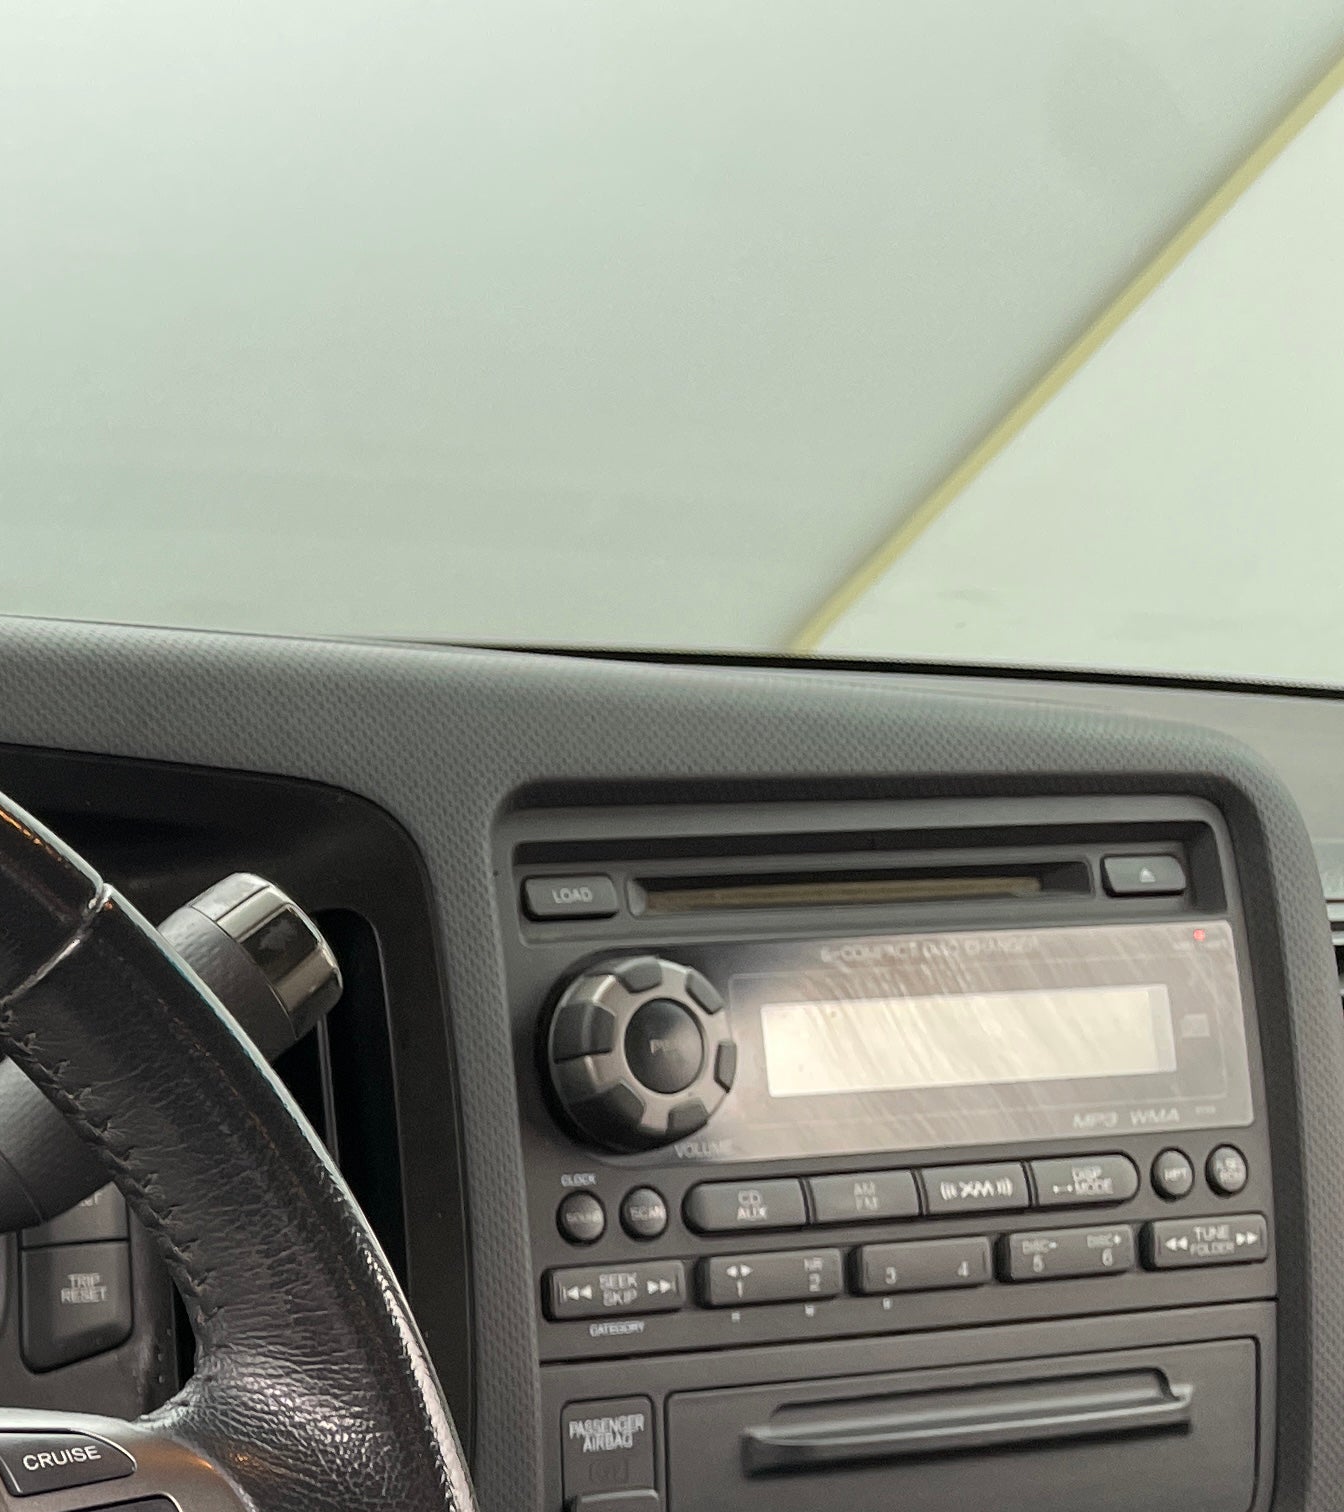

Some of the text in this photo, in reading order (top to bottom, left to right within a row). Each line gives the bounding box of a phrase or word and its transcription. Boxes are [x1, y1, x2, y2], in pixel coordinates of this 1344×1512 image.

[552, 886, 592, 904] LOAD
[1130, 1108, 1180, 1125] WMA
[737, 1190, 761, 1206] CD
[737, 1206, 768, 1222] AUX
[1193, 1224, 1230, 1242] TUNE
[885, 1267, 897, 1285] 3
[957, 1261, 969, 1278] 4
[68, 1272, 100, 1288] TRIP
[599, 1272, 638, 1291] SEEK
[808, 1273, 822, 1292] 2
[61, 1286, 107, 1304] RESET
[589, 1320, 645, 1338] CATEGORY
[569, 1413, 645, 1439] PASSENGER
[582, 1431, 633, 1453] AIRBAG
[21, 1445, 102, 1471] CRUISE
